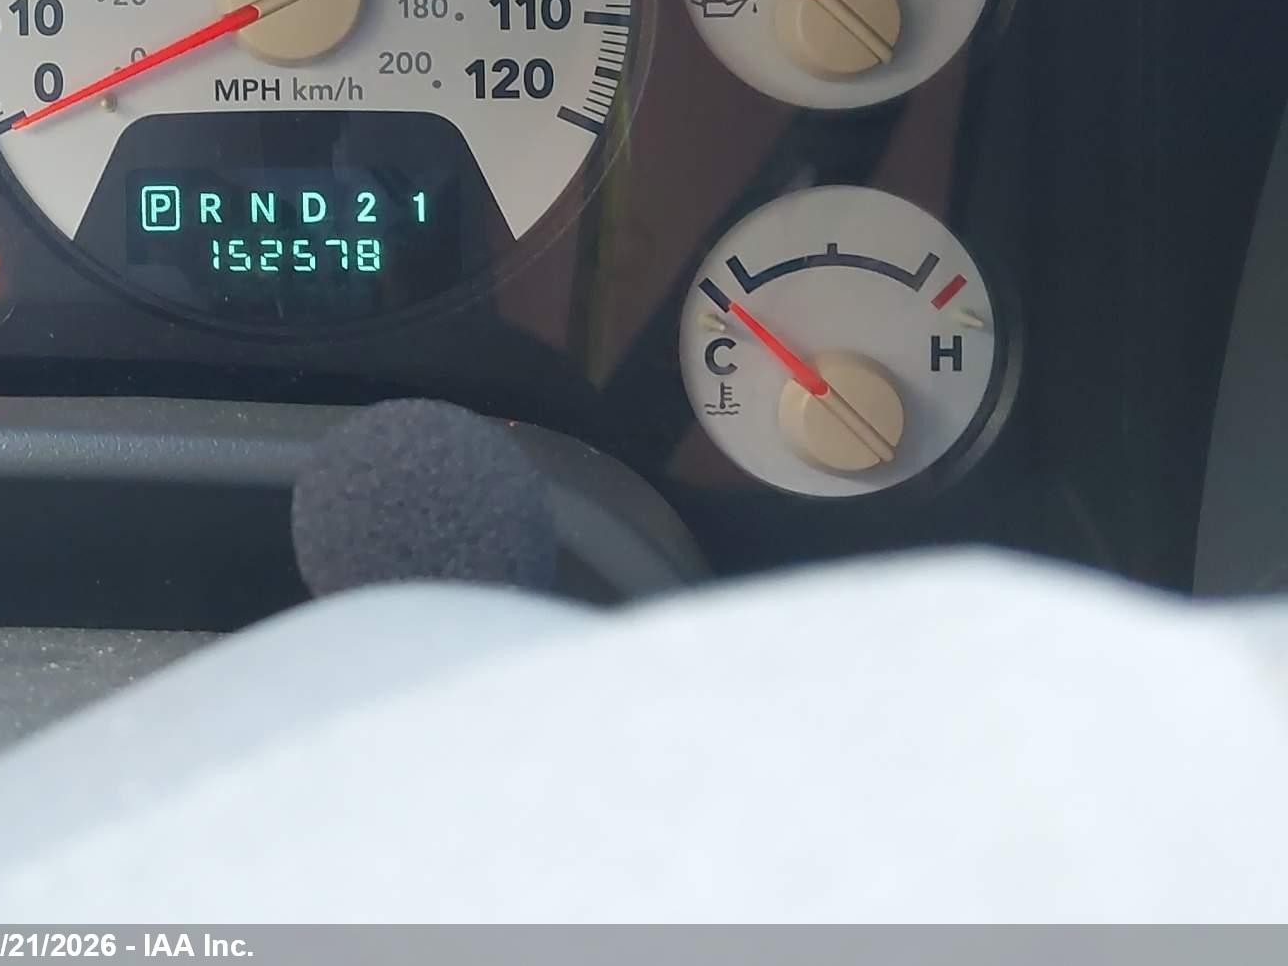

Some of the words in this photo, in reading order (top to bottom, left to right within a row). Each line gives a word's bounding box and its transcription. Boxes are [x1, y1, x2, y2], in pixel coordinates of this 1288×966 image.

[379, 52, 431, 74] 200
[465, 58, 554, 99] 120
[34, 63, 63, 101] 0
[215, 79, 280, 101] MPH
[293, 77, 363, 101] km/h
[151, 194, 170, 222] P
[201, 193, 221, 222] R
[252, 193, 274, 222] N
[303, 193, 326, 222] D
[358, 192, 376, 221] 2
[413, 192, 424, 221] 1
[213, 240, 380, 271] 152578
[705, 338, 737, 375] C
[931, 335, 962, 371] H
